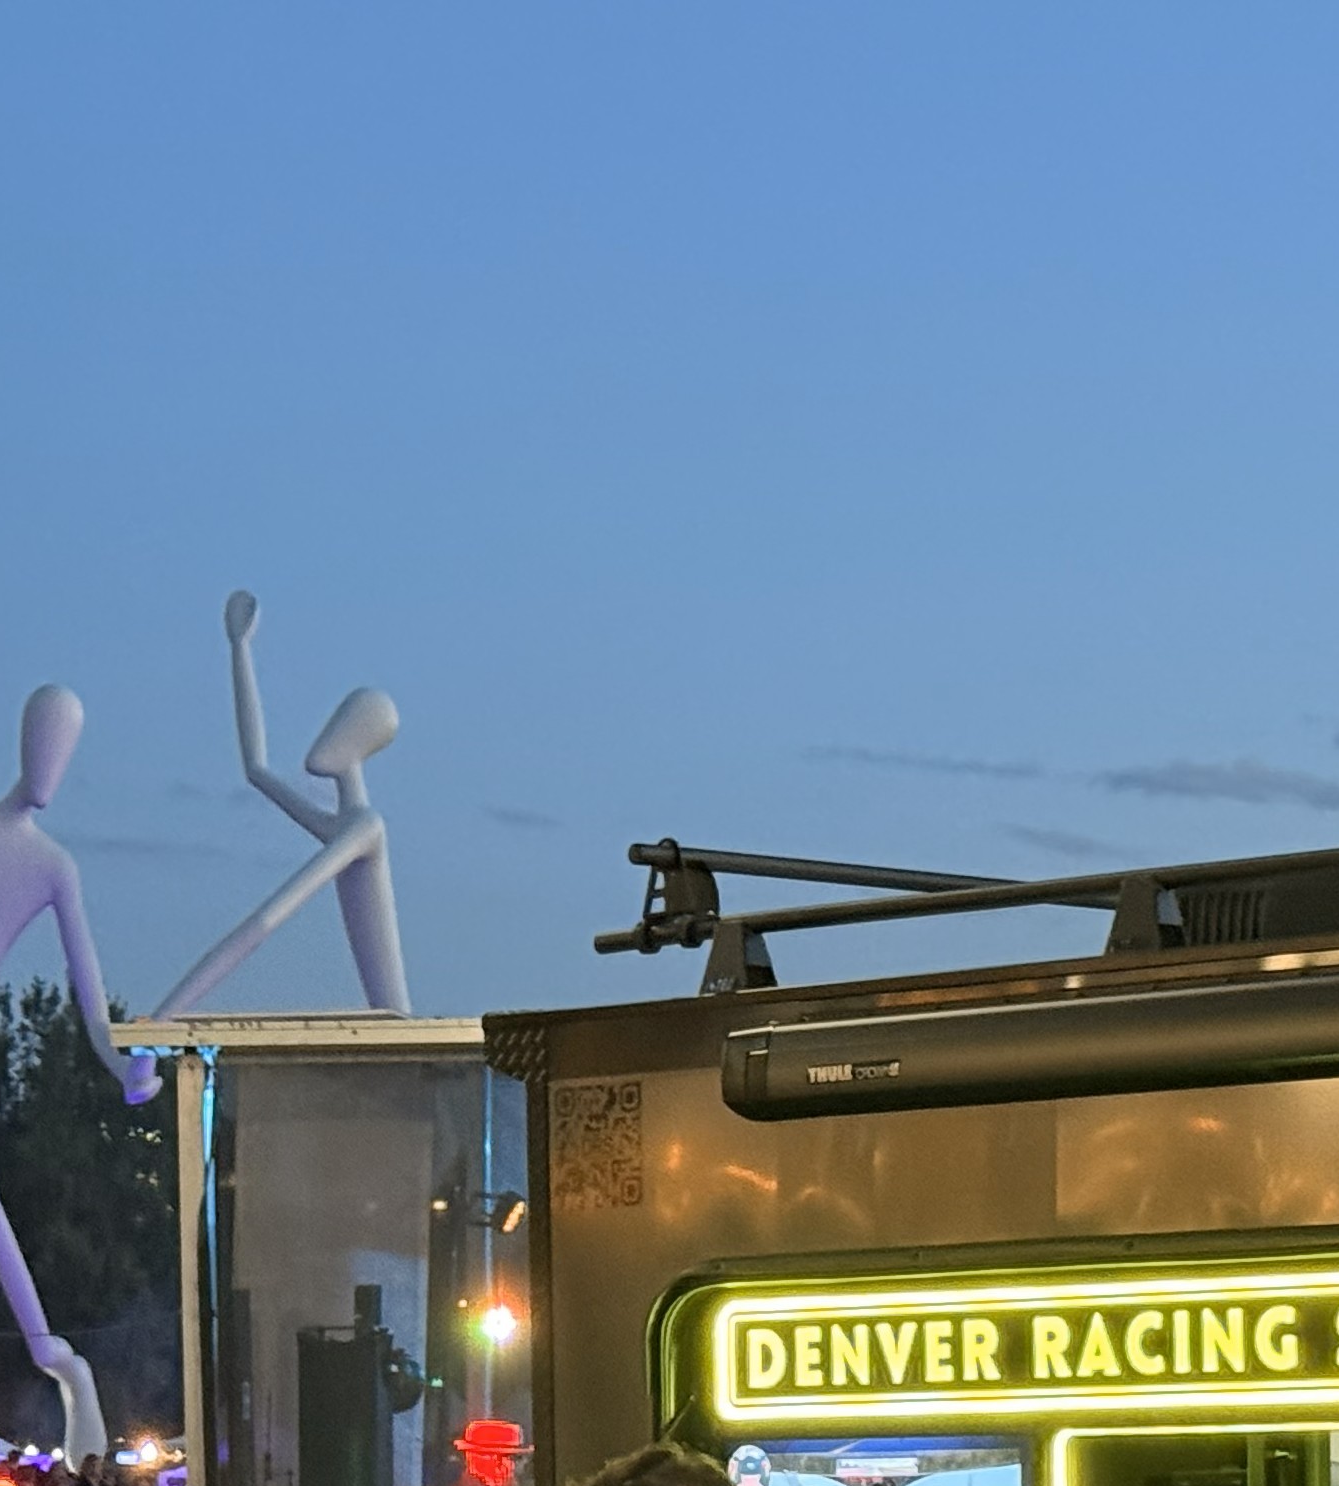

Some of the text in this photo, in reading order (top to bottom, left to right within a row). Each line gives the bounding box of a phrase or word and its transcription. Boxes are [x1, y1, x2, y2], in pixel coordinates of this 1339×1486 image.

[807, 1064, 853, 1084] THULE
[746, 1317, 1002, 1389] DENVER
[1032, 1304, 1299, 1379] RACING
